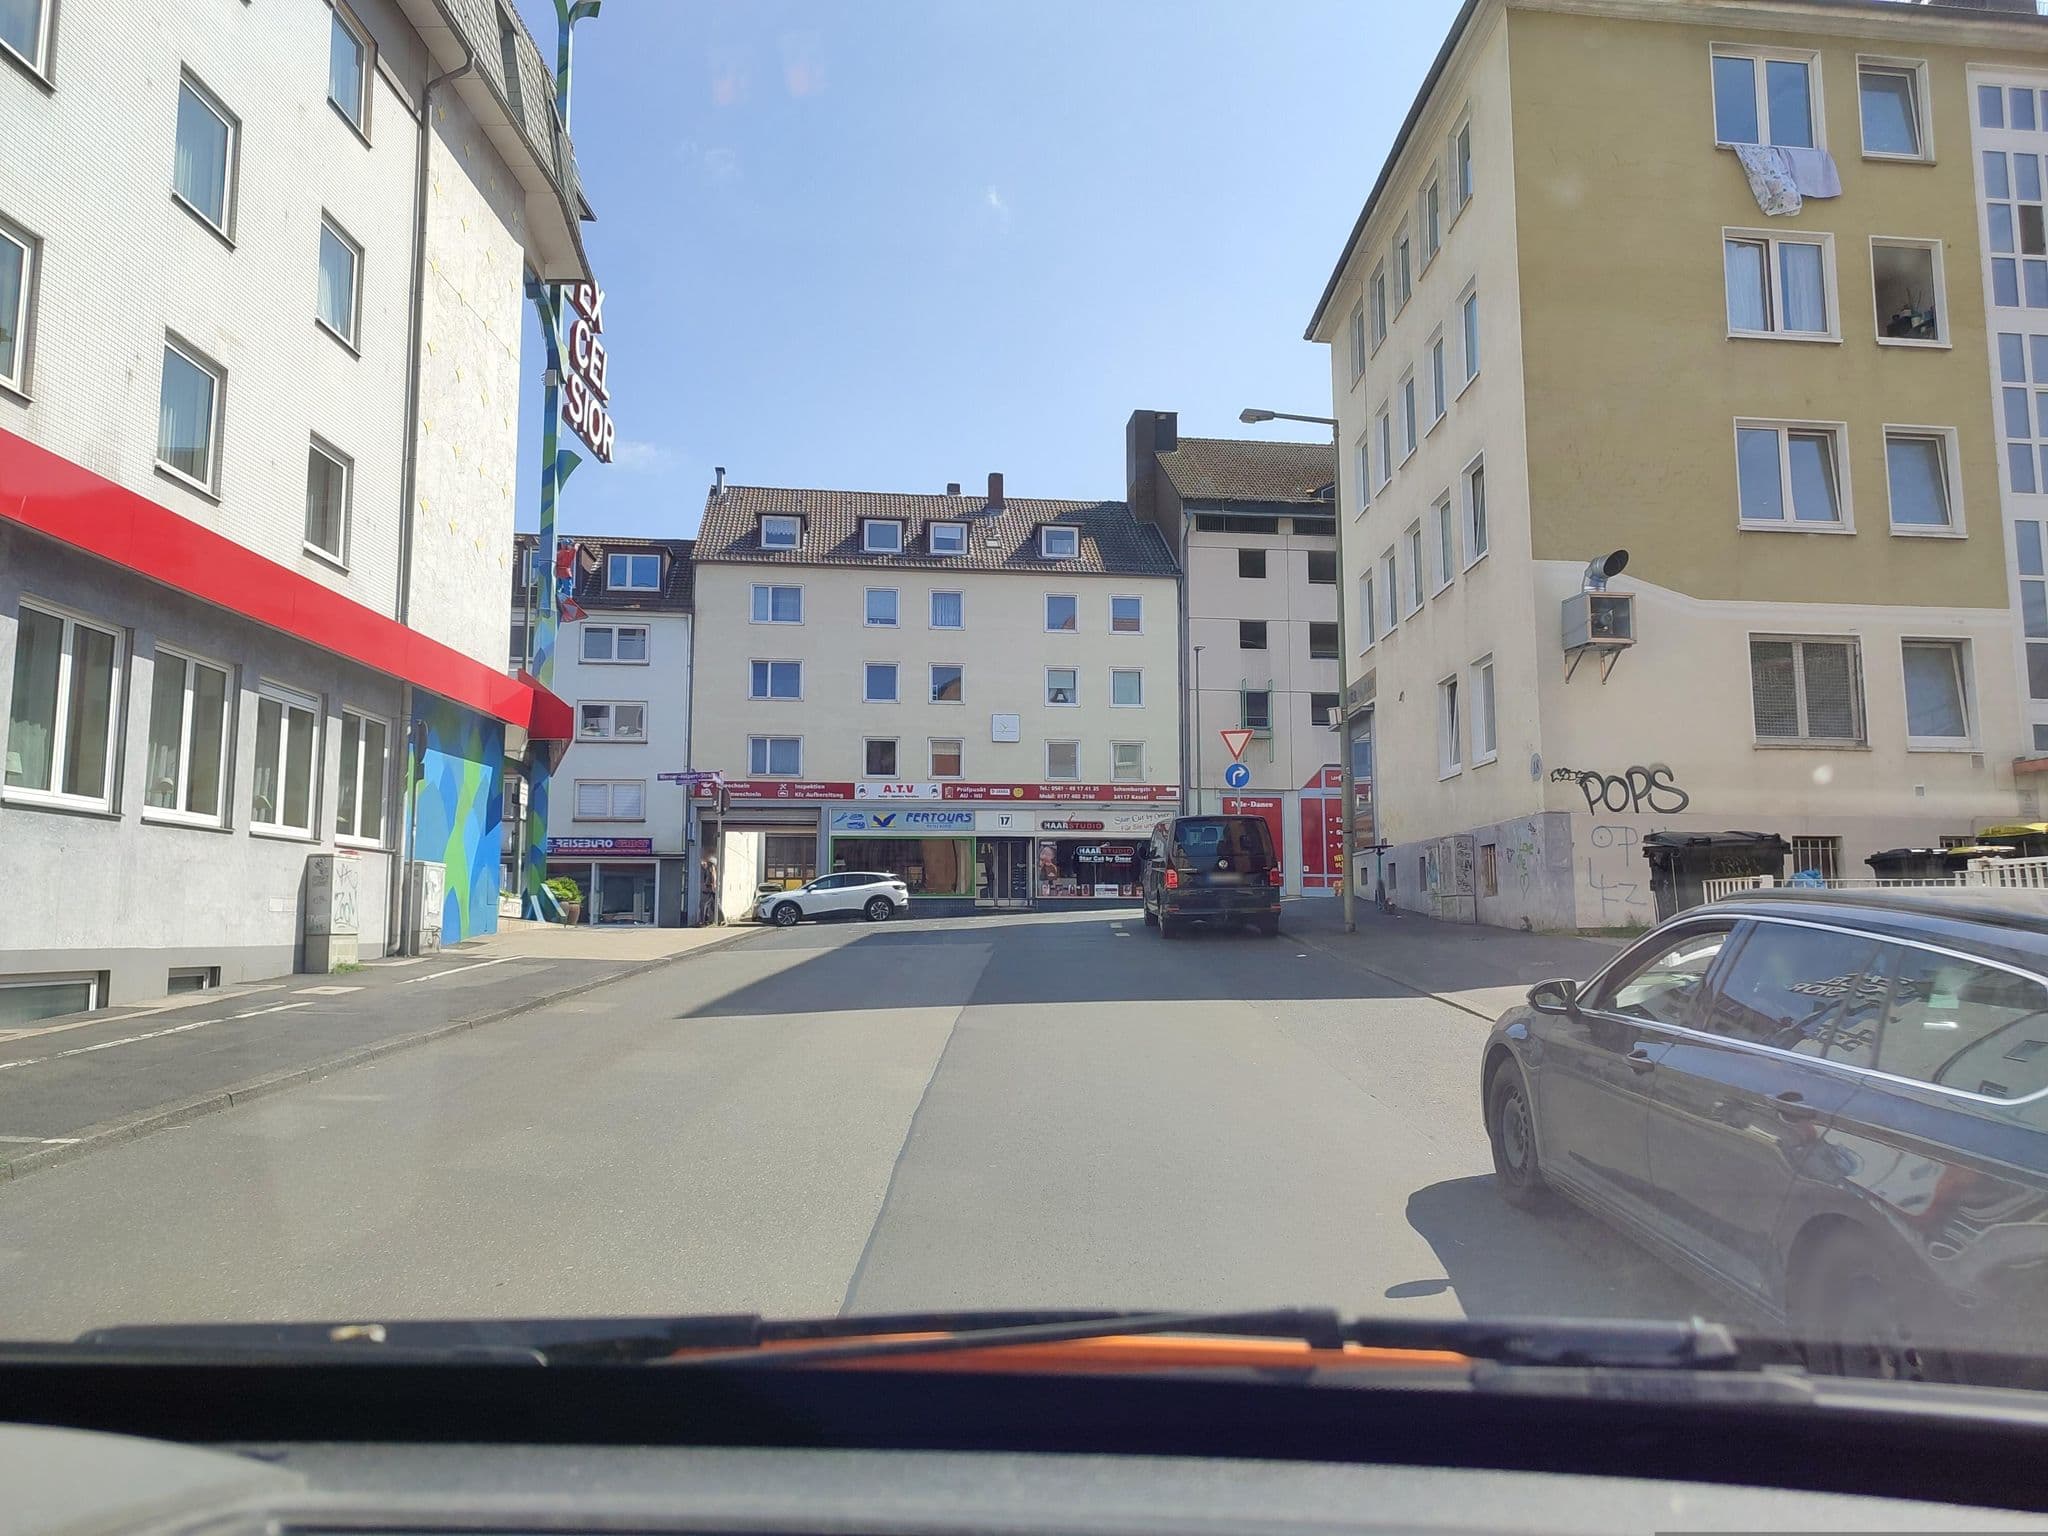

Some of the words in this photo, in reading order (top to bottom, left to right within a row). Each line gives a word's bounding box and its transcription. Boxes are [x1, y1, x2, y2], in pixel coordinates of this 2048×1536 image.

[575, 319, 610, 402] CEL
[568, 373, 616, 464] SIOR
[1579, 763, 1690, 816] POPS
[905, 812, 972, 823] FERTOURS
[1000, 816, 1010, 825] 17
